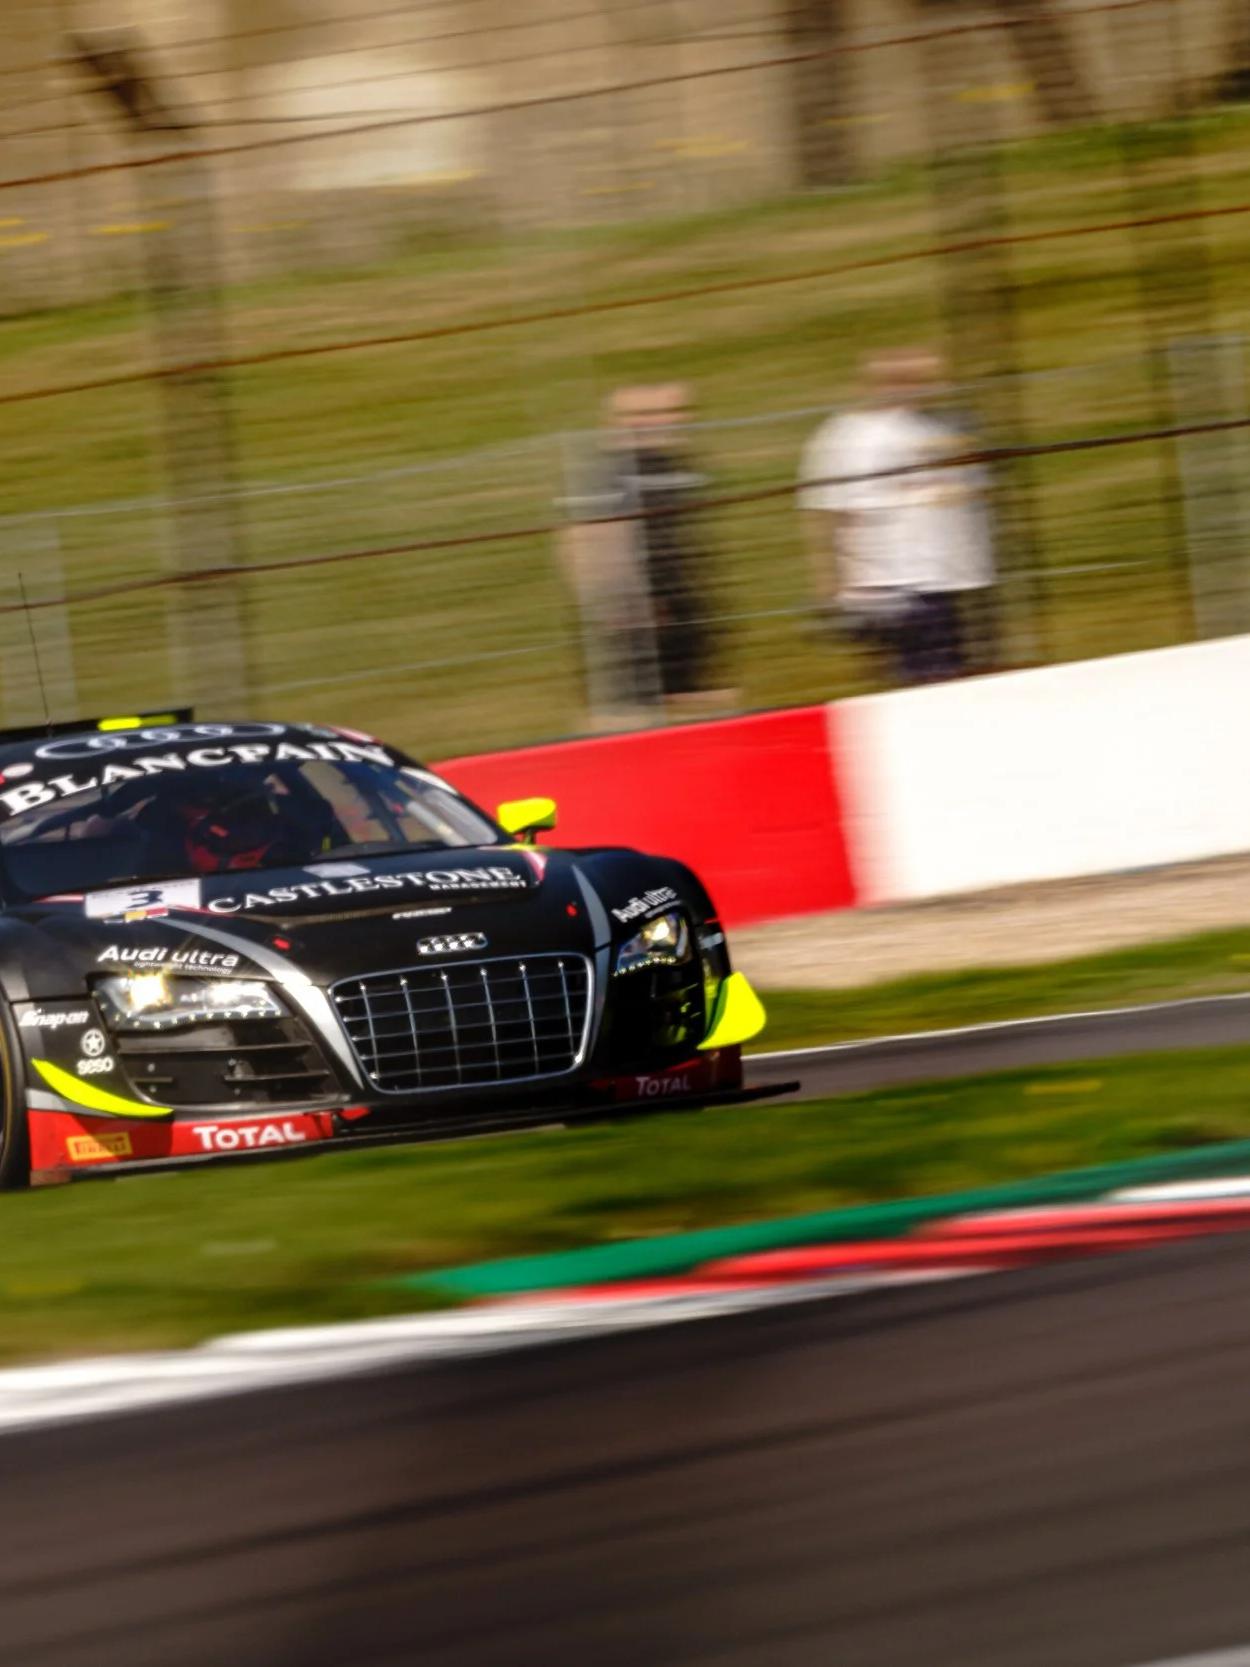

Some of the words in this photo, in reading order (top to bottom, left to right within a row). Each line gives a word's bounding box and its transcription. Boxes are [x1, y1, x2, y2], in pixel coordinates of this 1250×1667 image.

[126, 890, 164, 909] 3
[207, 867, 521, 914] CASTLESTONE
[611, 896, 650, 923] Audi
[96, 944, 168, 963] Audi
[170, 948, 240, 968] ultra
[635, 1076, 692, 1096] TOTAL
[193, 1122, 306, 1150] TOTAL
